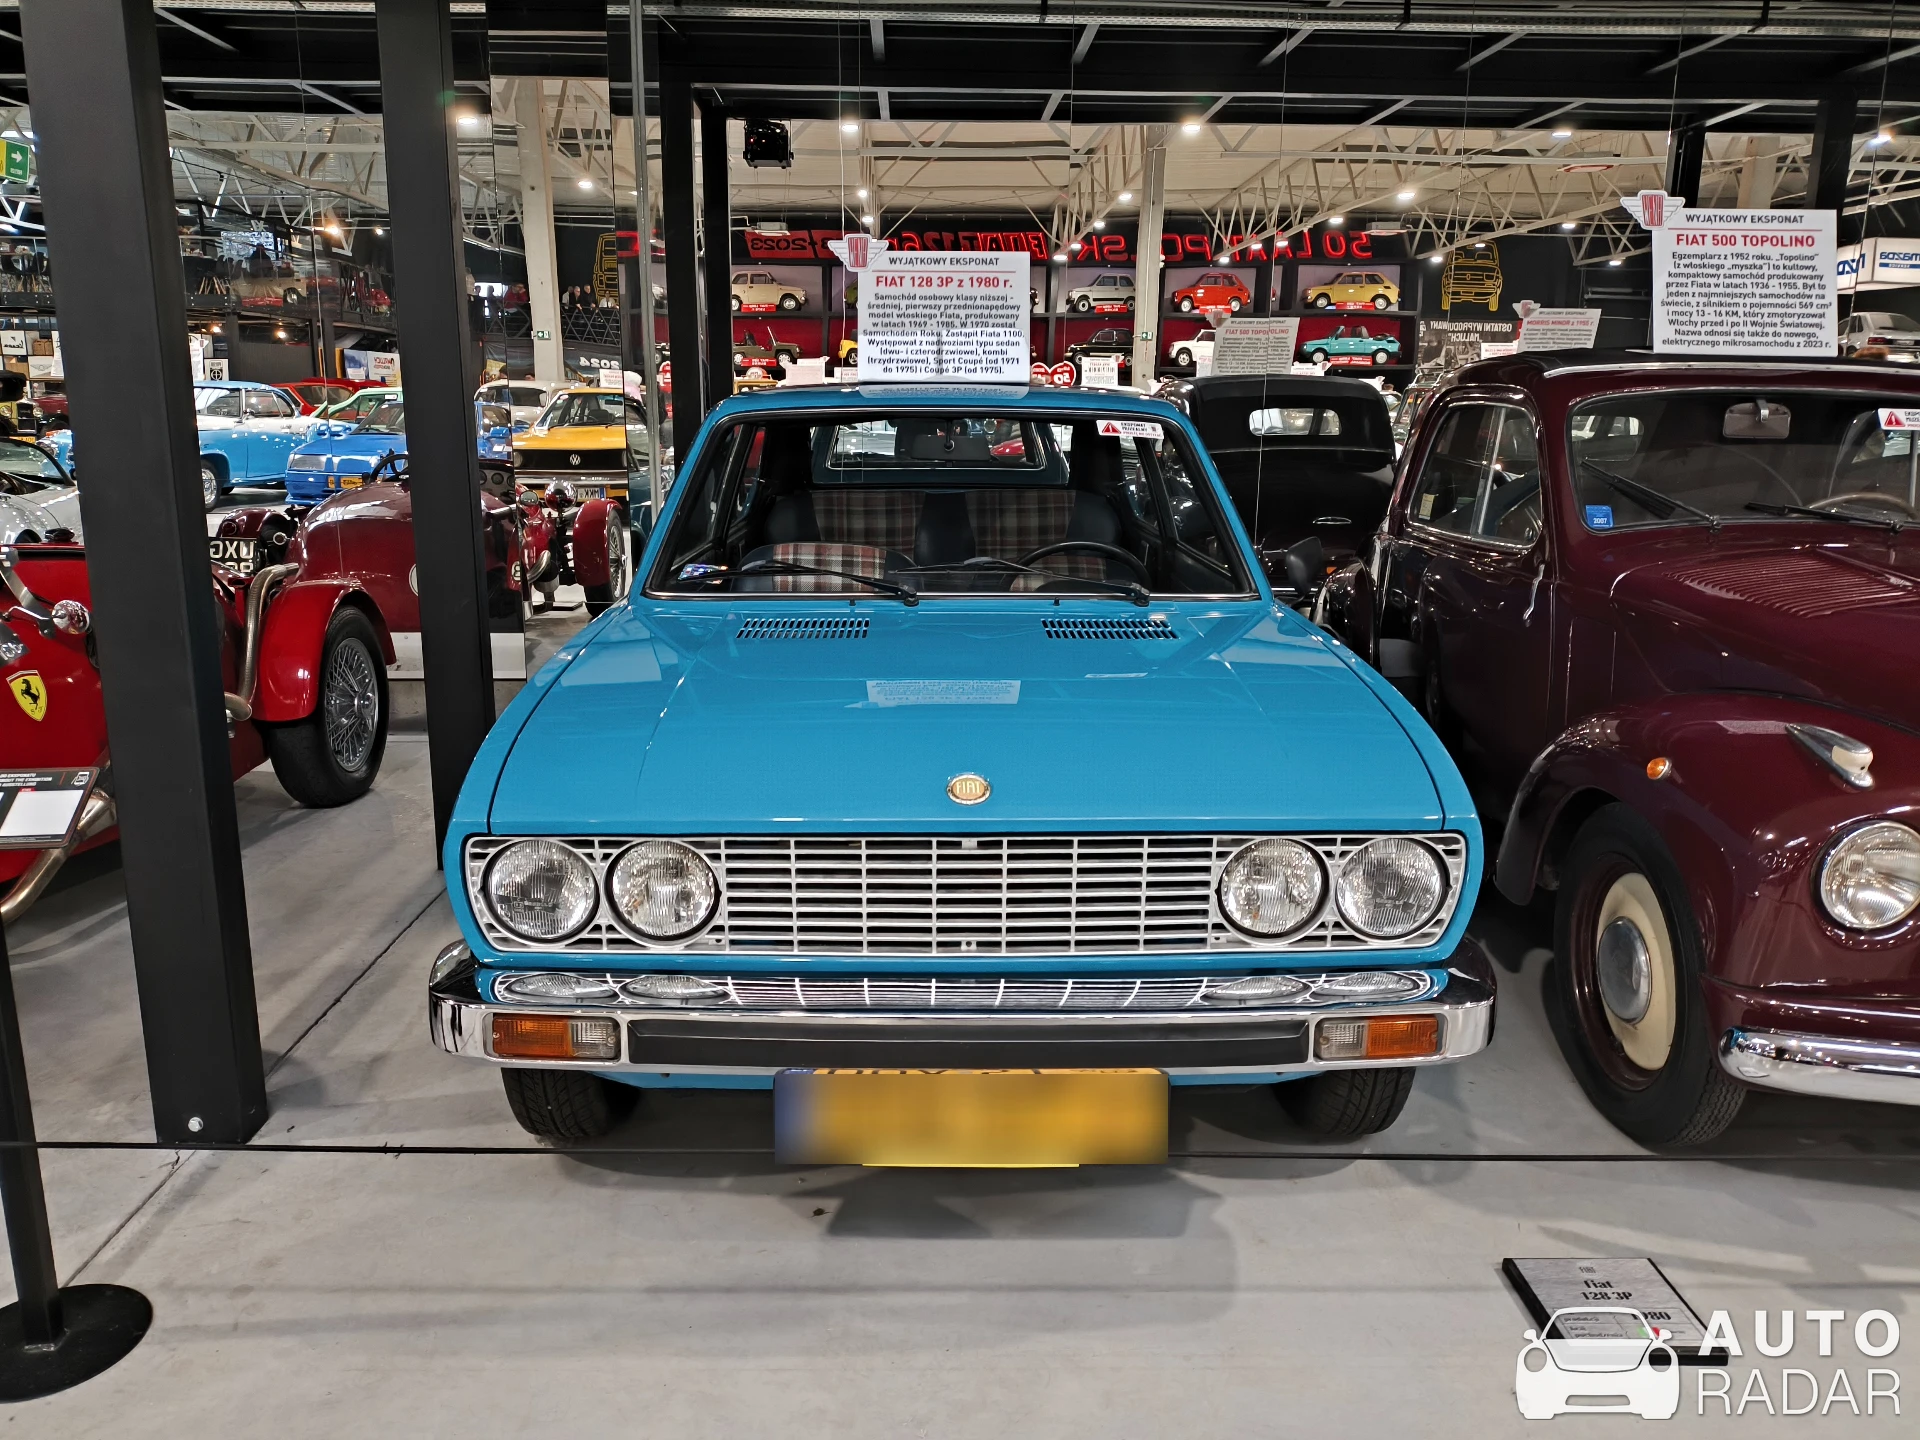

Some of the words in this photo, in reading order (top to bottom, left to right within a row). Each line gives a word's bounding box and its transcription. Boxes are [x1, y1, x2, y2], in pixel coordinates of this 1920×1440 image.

[1686, 214, 1748, 224] WYJĄTKOWY
[1751, 215, 1804, 224] EKSPONAT
[1677, 234, 1708, 246] FIAT
[1712, 235, 1736, 246] 500
[1741, 235, 1815, 247] TOPOLINO
[889, 257, 947, 267] WYJĄTKOWY
[950, 258, 999, 266] EKSPONAT
[1672, 252, 1722, 262] Egzemplarz
[1752, 253, 1773, 261] roku.
[1683, 262, 1725, 271] włoskiego
[1783, 262, 1818, 272] kultowy,
[1668, 270, 1721, 280] kompaktowy
[1723, 271, 1765, 279] samochód
[1767, 272, 1824, 281] produkowany
[876, 276, 905, 287] FIAT
[910, 276, 932, 288] 128
[937, 276, 953, 287] 3P
[958, 279, 964, 288] z
[969, 277, 999, 288] 1980
[1004, 280, 1012, 288] r.
[1723, 281, 1748, 289] latach
[1750, 281, 1770, 289] 1936
[1778, 282, 1800, 290] 1955.
[1802, 282, 1816, 291] Był
[1818, 281, 1826, 290] to
[875, 293, 916, 301] Samochód
[919, 294, 954, 302] osobowy
[956, 294, 978, 302] klasy
[980, 294, 1007, 302] niższej
[1666, 290, 1689, 299] jeden
[1698, 291, 1756, 300] najmniejszych
[1758, 290, 1813, 299] samochodów
[868, 302, 903, 312] średniej,
[906, 302, 942, 312] pierwszy
[942, 302, 1020, 312] przednionapędowy
[1661, 299, 1694, 308] świecie,
[1702, 299, 1740, 308] silnikiem
[1742, 300, 1747, 308] o
[1750, 301, 1796, 310] pojemności
[1799, 301, 1814, 309] 569
[869, 311, 894, 321] model
[896, 311, 937, 320] włoskiego
[940, 312, 962, 321] Fiata,
[965, 312, 1019, 321] produkowany
[1725, 310, 1741, 319] KM,
[1743, 309, 1765, 319] który
[1767, 312, 1825, 320] zmotoryzował
[881, 320, 906, 328] latach
[936, 321, 958, 329] 1985.
[960, 321, 968, 329] W
[970, 320, 989, 329] 1970
[991, 320, 1016, 329] został
[1668, 318, 1698, 328] Włochy
[1700, 320, 1724, 328] przed
[1750, 319, 1778, 329] Wojnie
[1780, 319, 1825, 329] Światowej.
[920, 330, 943, 338] Roku.
[946, 329, 978, 338] Zastąpił
[980, 330, 1000, 338] Fiata
[1675, 328, 1702, 336] Nazwa
[1704, 328, 1732, 336] odnosi
[1733, 330, 1745, 338] się
[1748, 329, 1770, 337] także
[1784, 329, 1820, 339] nowego,
[868, 339, 916, 348] Występował
[926, 339, 973, 348] nadwoziami
[976, 340, 993, 348] typu
[1662, 338, 1720, 348] elektrycznego
[1723, 339, 1794, 347] mikrosamochodu
[1803, 339, 1823, 348] 2023
[934, 356, 955, 366] Sport
[958, 357, 983, 366] Coupé
[924, 365, 949, 375] Coupé
[956, 780, 981, 794] FIAT
[1580, 1291, 1609, 1301] 128
[1611, 1291, 1632, 1301] 3P
